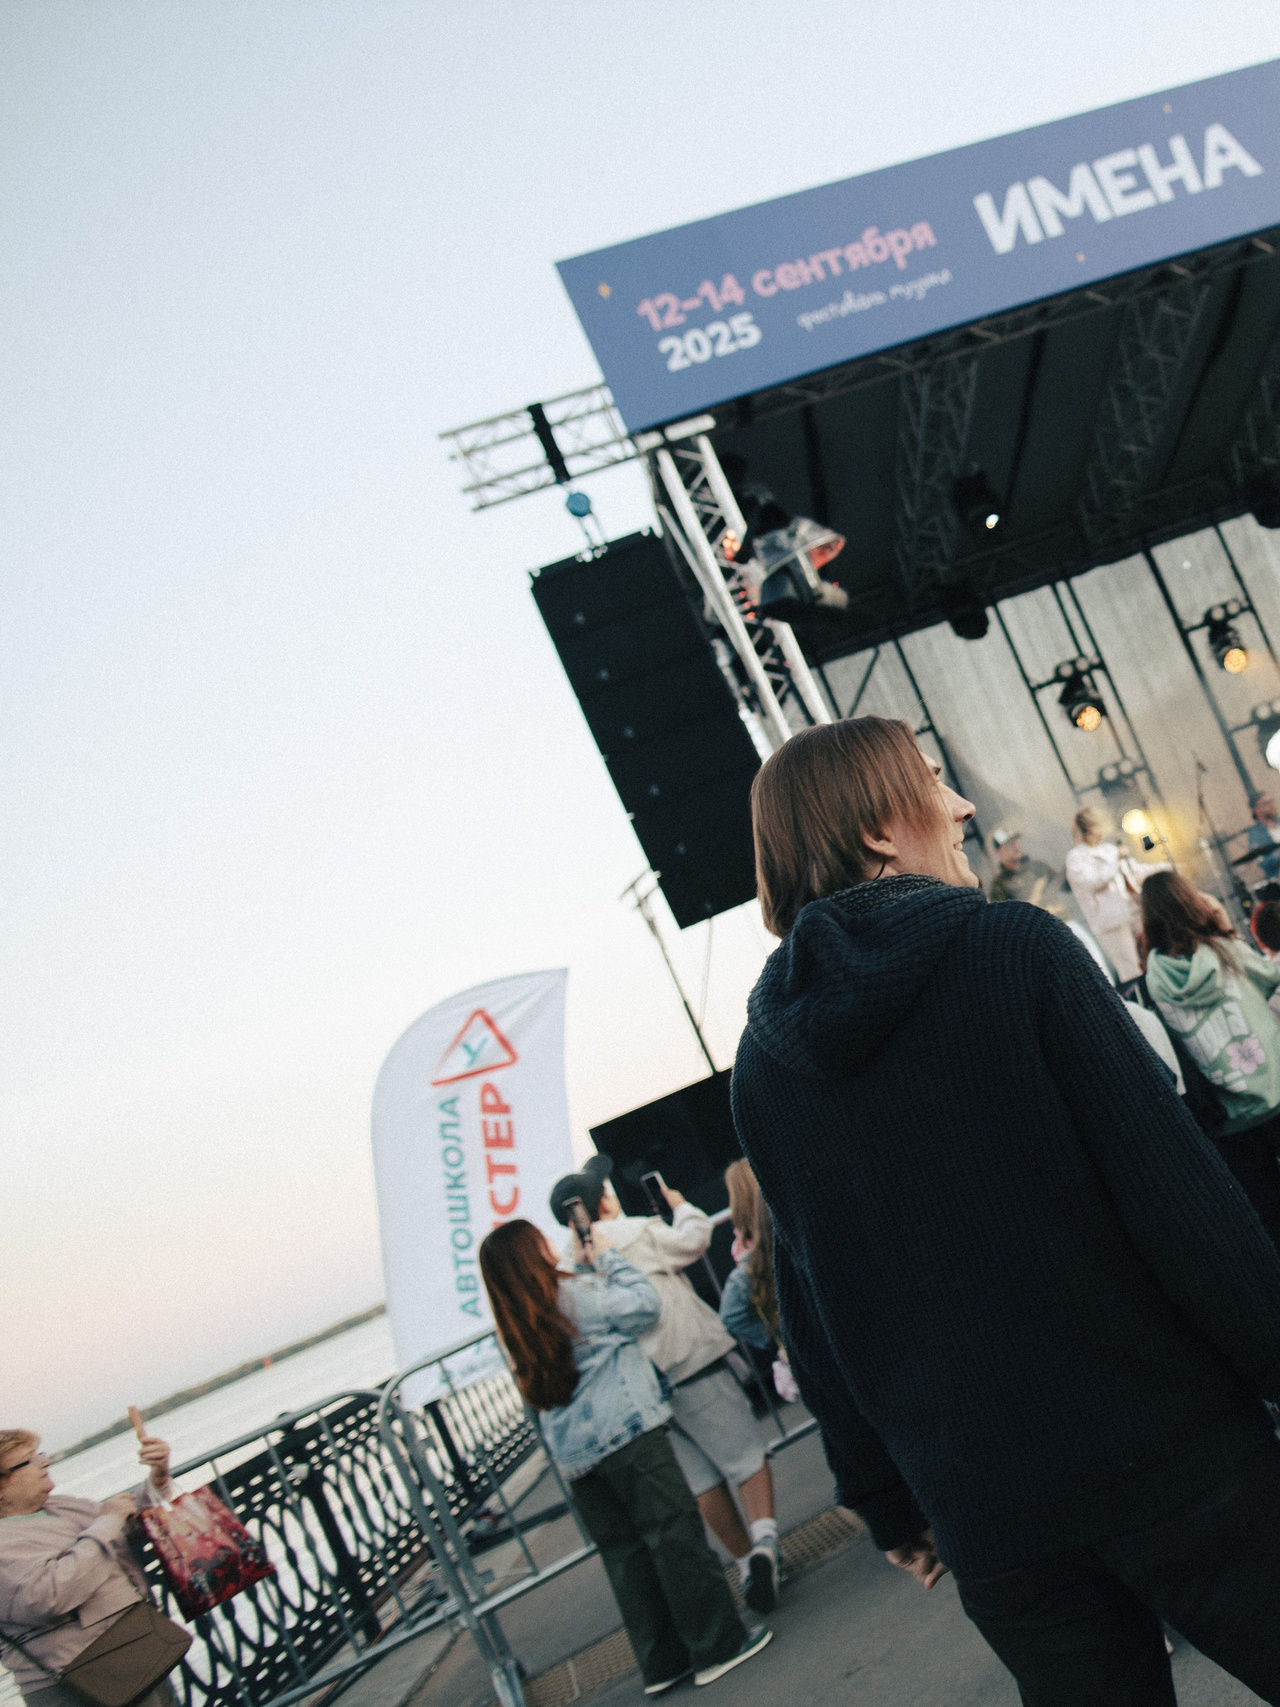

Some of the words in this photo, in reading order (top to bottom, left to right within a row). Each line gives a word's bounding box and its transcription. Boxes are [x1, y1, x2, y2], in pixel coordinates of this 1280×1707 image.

[972, 122, 1265, 255] ИМЕНА
[637, 274, 746, 331] 12-14
[751, 221, 937, 297] сентября
[658, 313, 761, 372] 2025
[438, 1096, 482, 1318] АВТОШКОЛА
[480, 1081, 521, 1228] СТЕР
